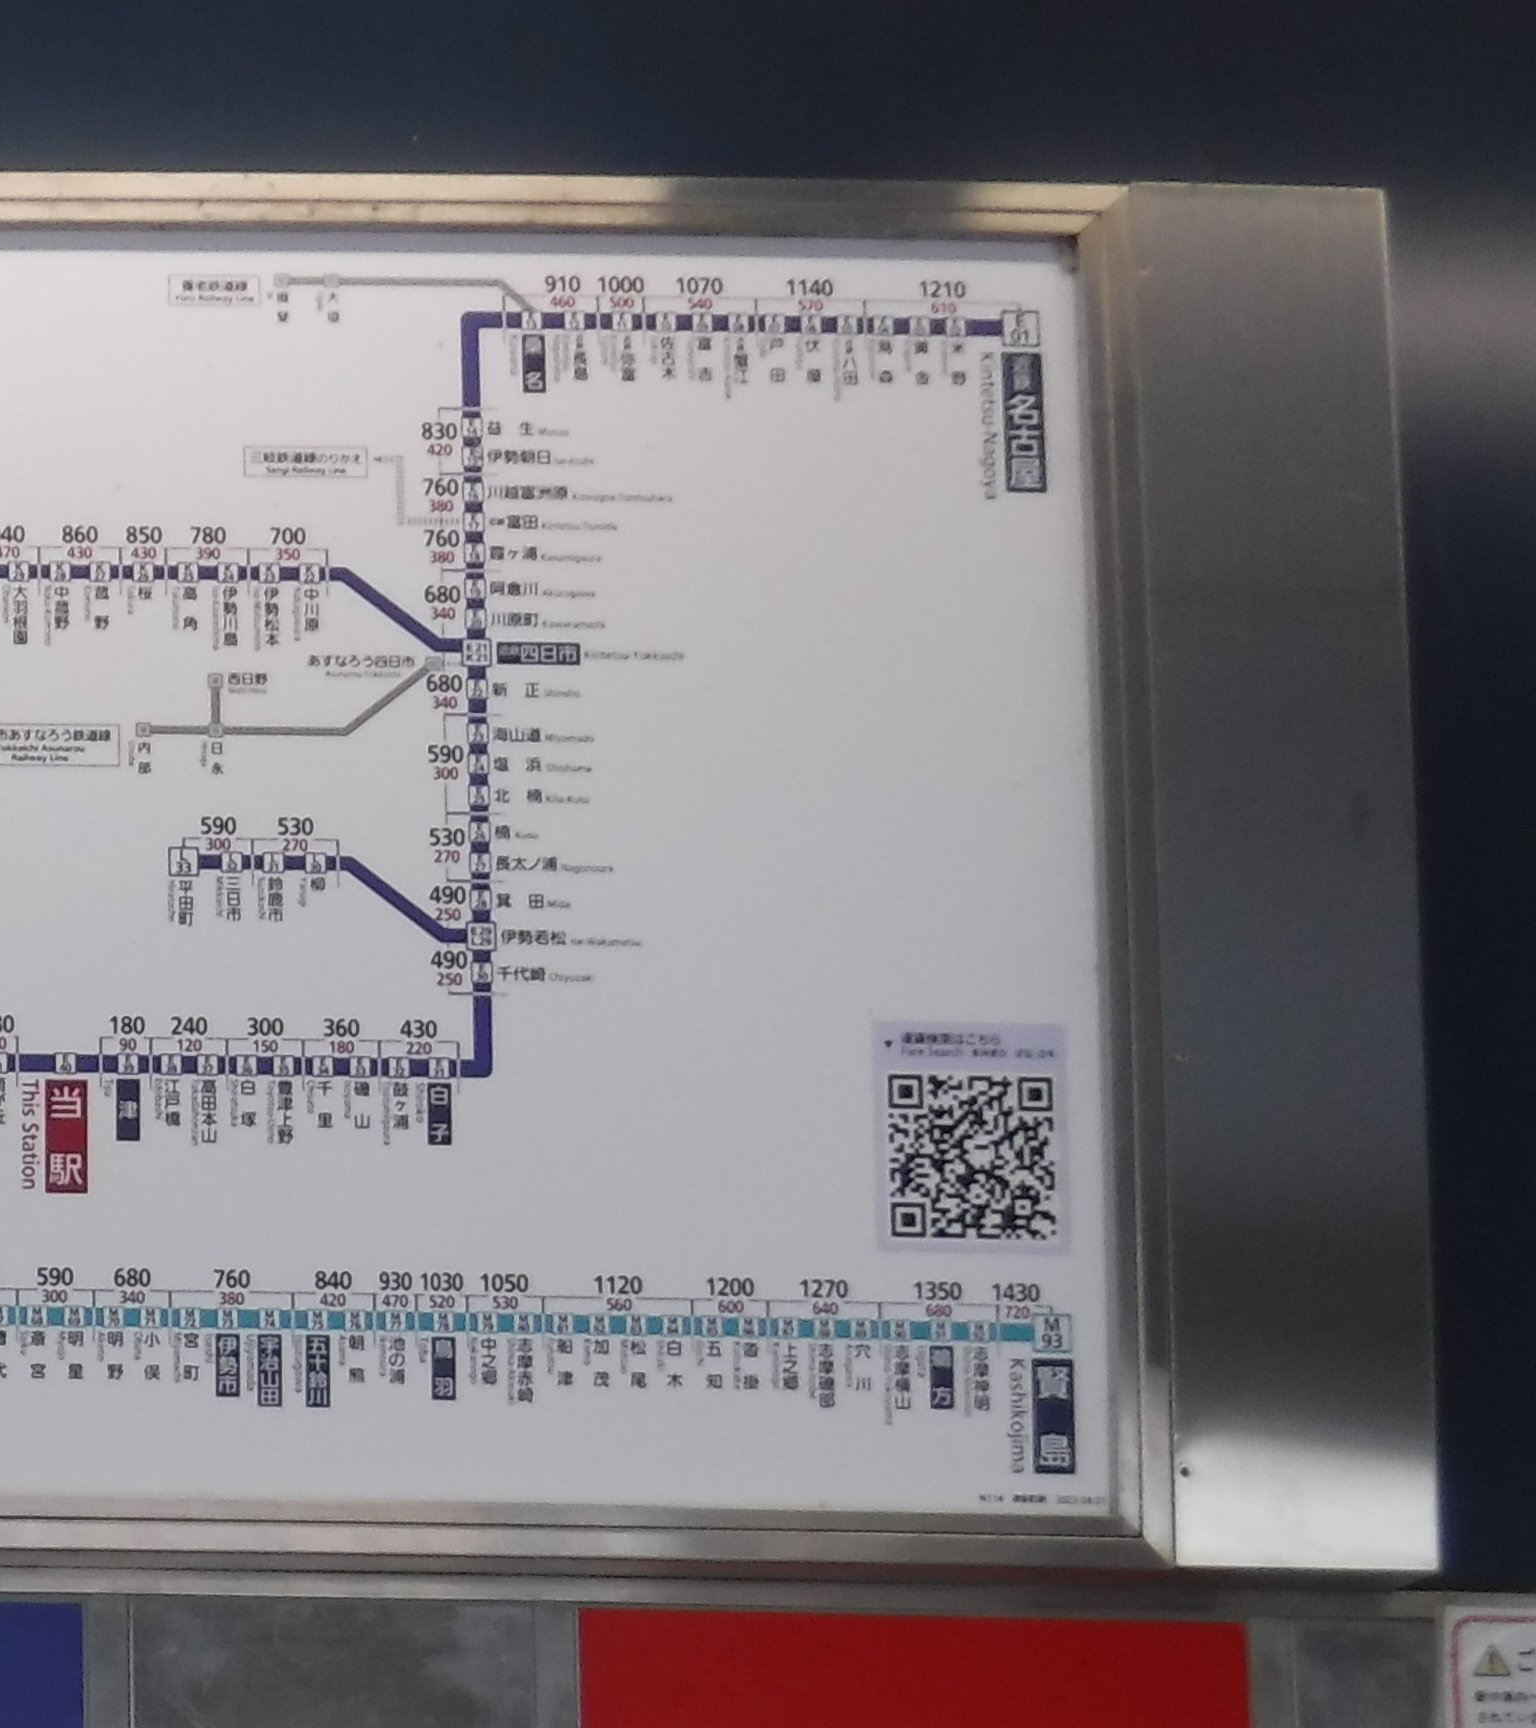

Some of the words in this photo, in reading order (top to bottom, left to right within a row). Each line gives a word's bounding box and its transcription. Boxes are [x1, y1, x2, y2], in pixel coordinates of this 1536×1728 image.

[545, 276, 580, 293] 910
[598, 276, 644, 294] 1000
[677, 277, 723, 295] 1070
[787, 279, 833, 297] 1140
[921, 281, 966, 299] 1210
[422, 422, 457, 440] 830
[423, 478, 458, 497] 760
[62, 525, 98, 543] 860
[126, 526, 162, 544] 850
[191, 527, 226, 544] 780
[271, 527, 306, 545] 700
[425, 585, 460, 604] 680
[427, 674, 462, 693] 680
[428, 745, 464, 763] 590
[278, 817, 314, 836] 530
[429, 886, 466, 904] 490
[110, 1016, 145, 1035] 180
[248, 1017, 283, 1036] 300
[324, 1019, 359, 1037] 360
[21, 1078, 40, 1116] This
[50, 1085, 83, 1186] 当駅
[22, 1134, 37, 1189] Station
[315, 1271, 352, 1290] 840
[379, 1272, 412, 1291] 930
[421, 1272, 463, 1292] 1030
[481, 1274, 528, 1292] 1050
[594, 1276, 643, 1294] 1120
[707, 1277, 754, 1297] 1200
[800, 1279, 848, 1298] 1270
[914, 1281, 962, 1301] 1350
[992, 1283, 1040, 1302] 1430
[1007, 1359, 1028, 1473] Kashikojima
